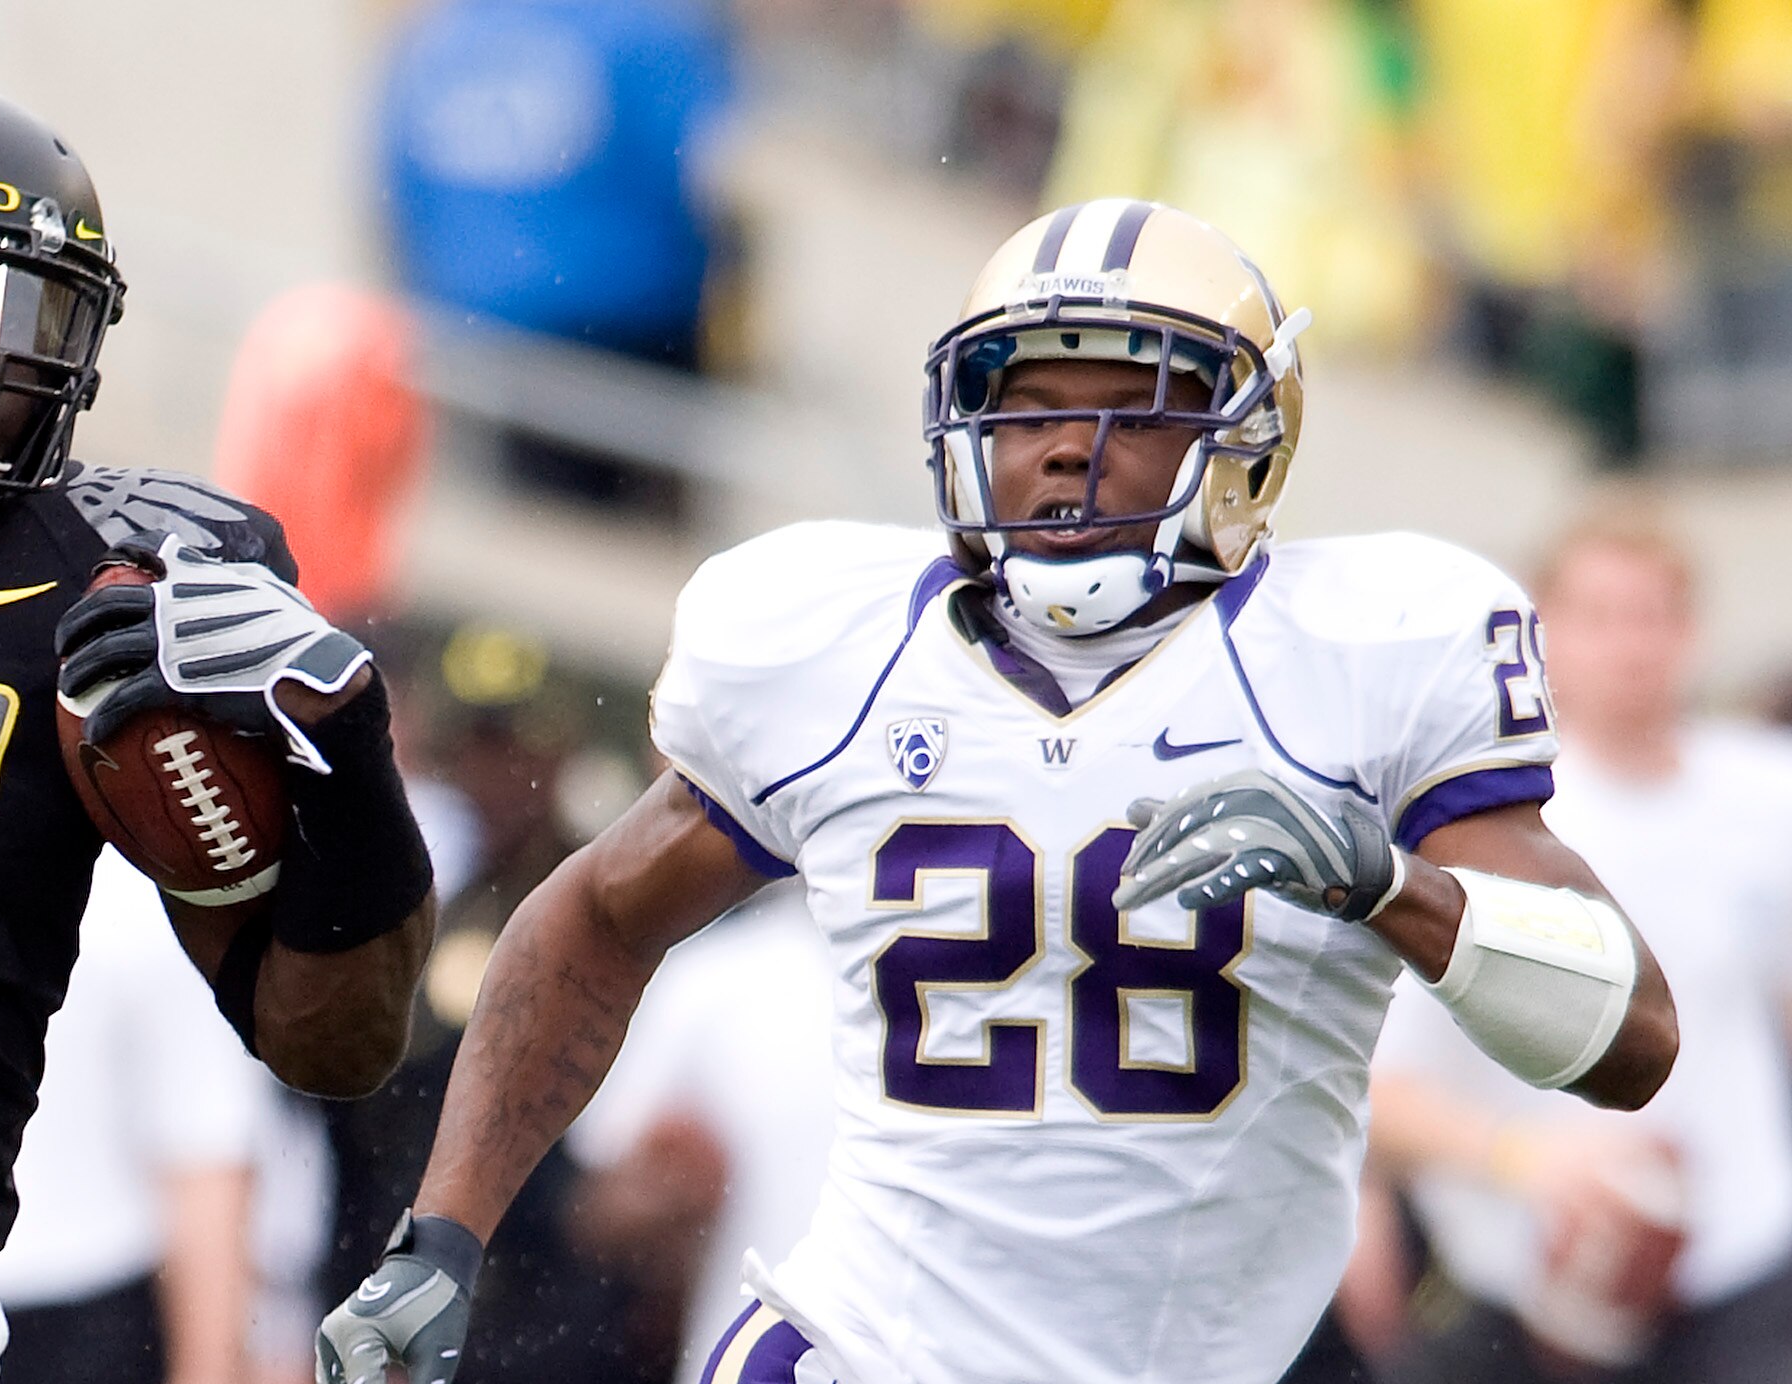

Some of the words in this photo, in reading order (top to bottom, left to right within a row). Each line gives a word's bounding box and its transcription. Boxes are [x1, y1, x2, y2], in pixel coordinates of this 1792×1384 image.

[888, 719, 945, 764] PAC
[1038, 738, 1077, 764] W
[902, 747, 936, 778] 10
[866, 816, 1255, 1123] 28
